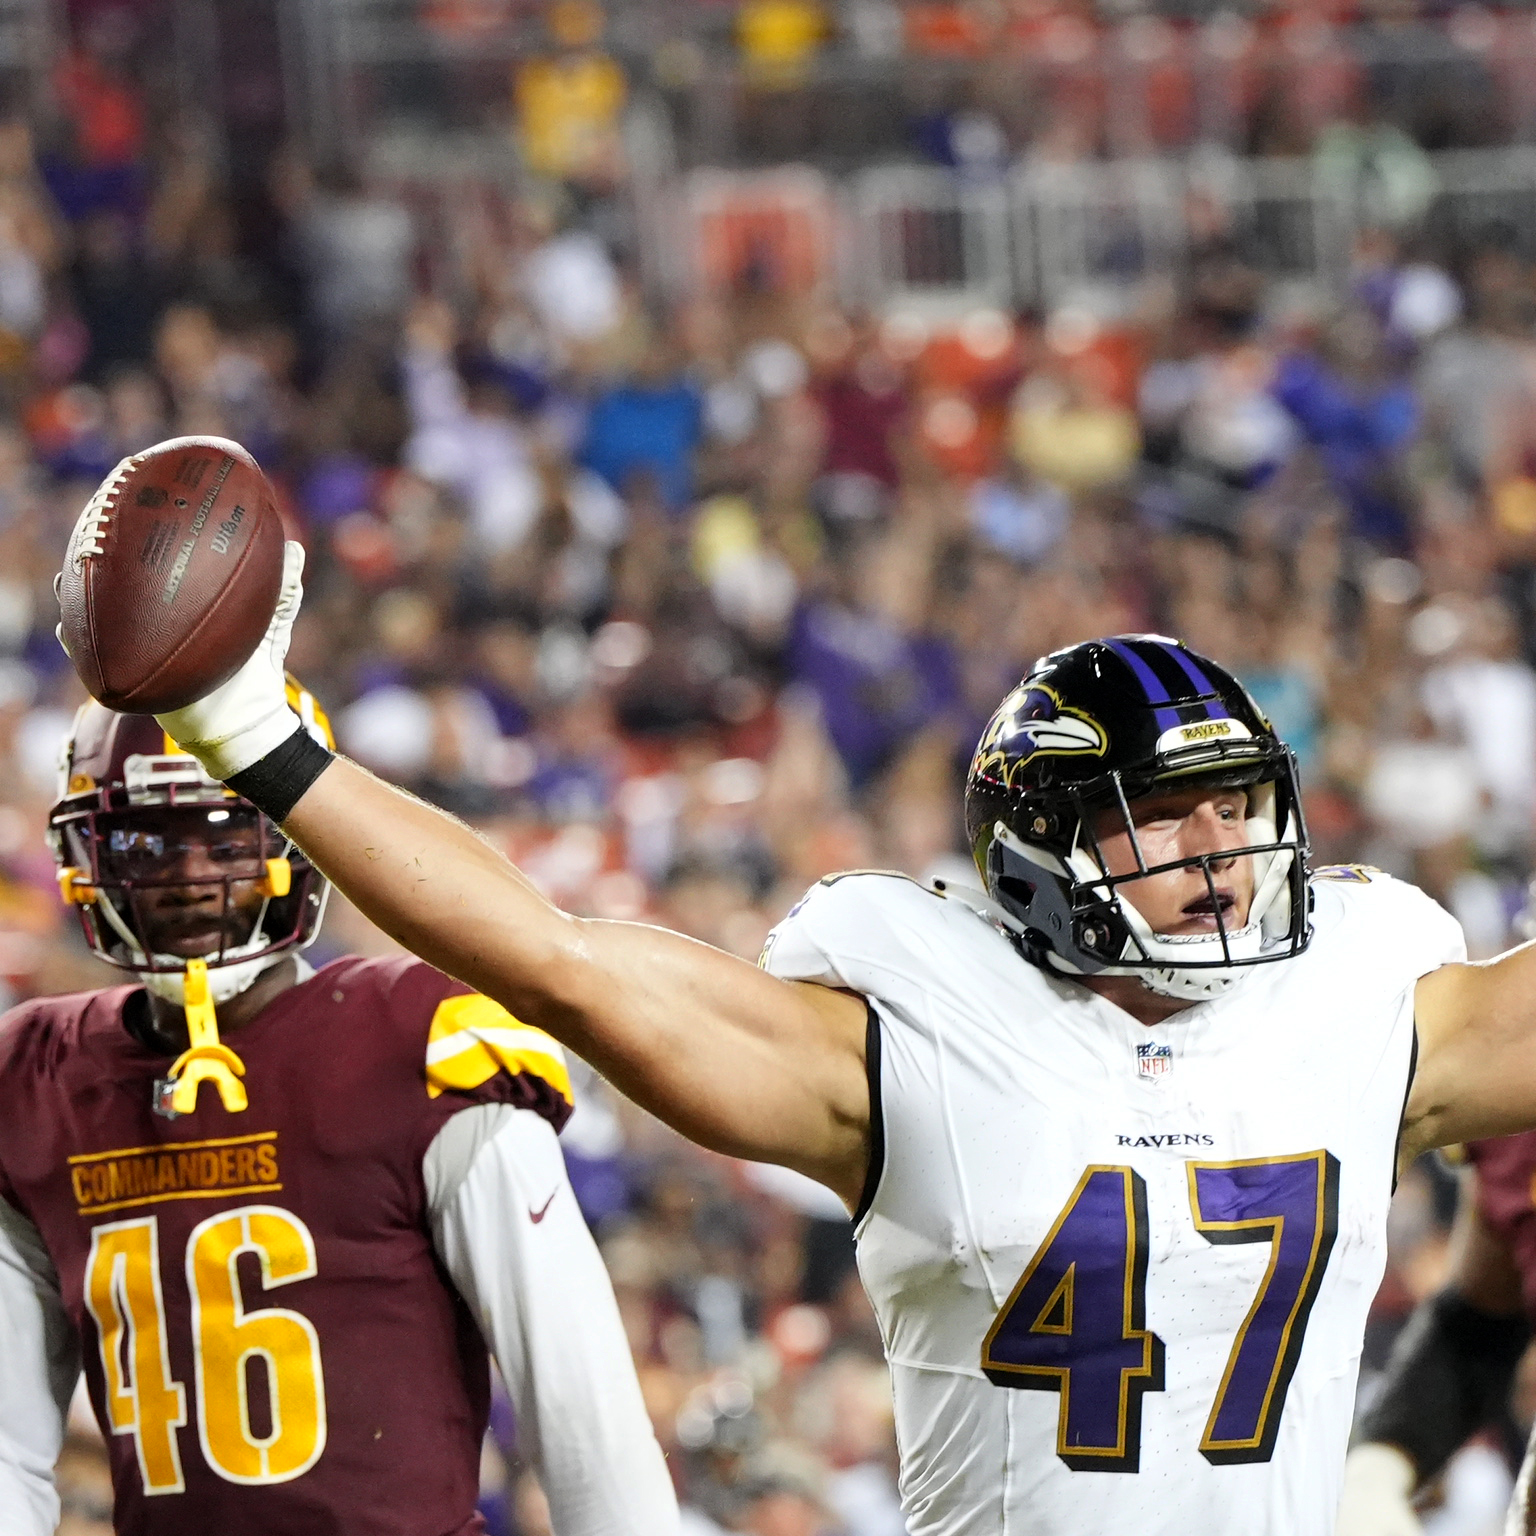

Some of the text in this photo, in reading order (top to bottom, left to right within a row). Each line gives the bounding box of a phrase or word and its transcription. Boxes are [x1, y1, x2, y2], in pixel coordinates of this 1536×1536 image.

[189, 483, 220, 536] FOOTBALL
[210, 505, 246, 555] Wilson
[1182, 722, 1231, 741] RAVENS
[1139, 1057, 1170, 1077] NFL
[1115, 1133, 1215, 1149] RAVENS
[71, 1144, 280, 1203] COMMANDERS
[979, 1148, 1342, 1474] 47
[83, 1204, 327, 1497] 46
